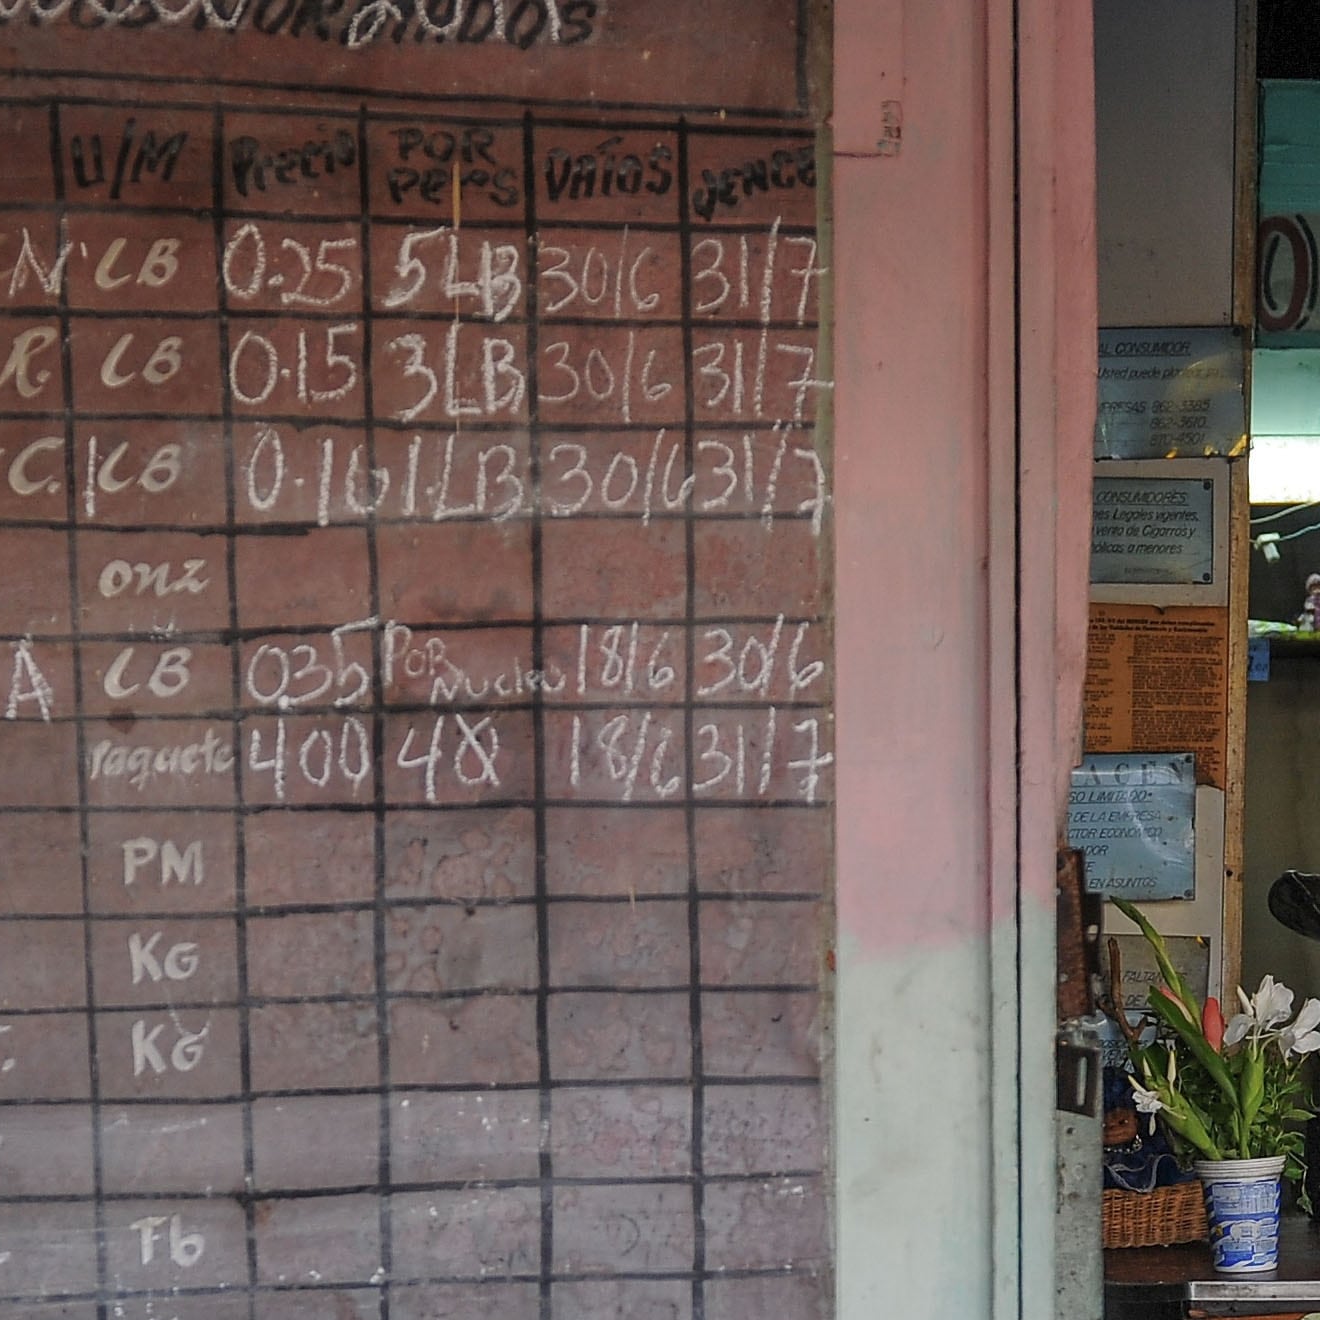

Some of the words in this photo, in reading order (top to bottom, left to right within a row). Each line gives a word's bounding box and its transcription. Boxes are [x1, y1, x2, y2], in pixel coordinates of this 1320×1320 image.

[95, 238, 180, 290] LB
[100, 333, 183, 388] LB
[104, 645, 191, 699] LB
[122, 837, 204, 887] PM
